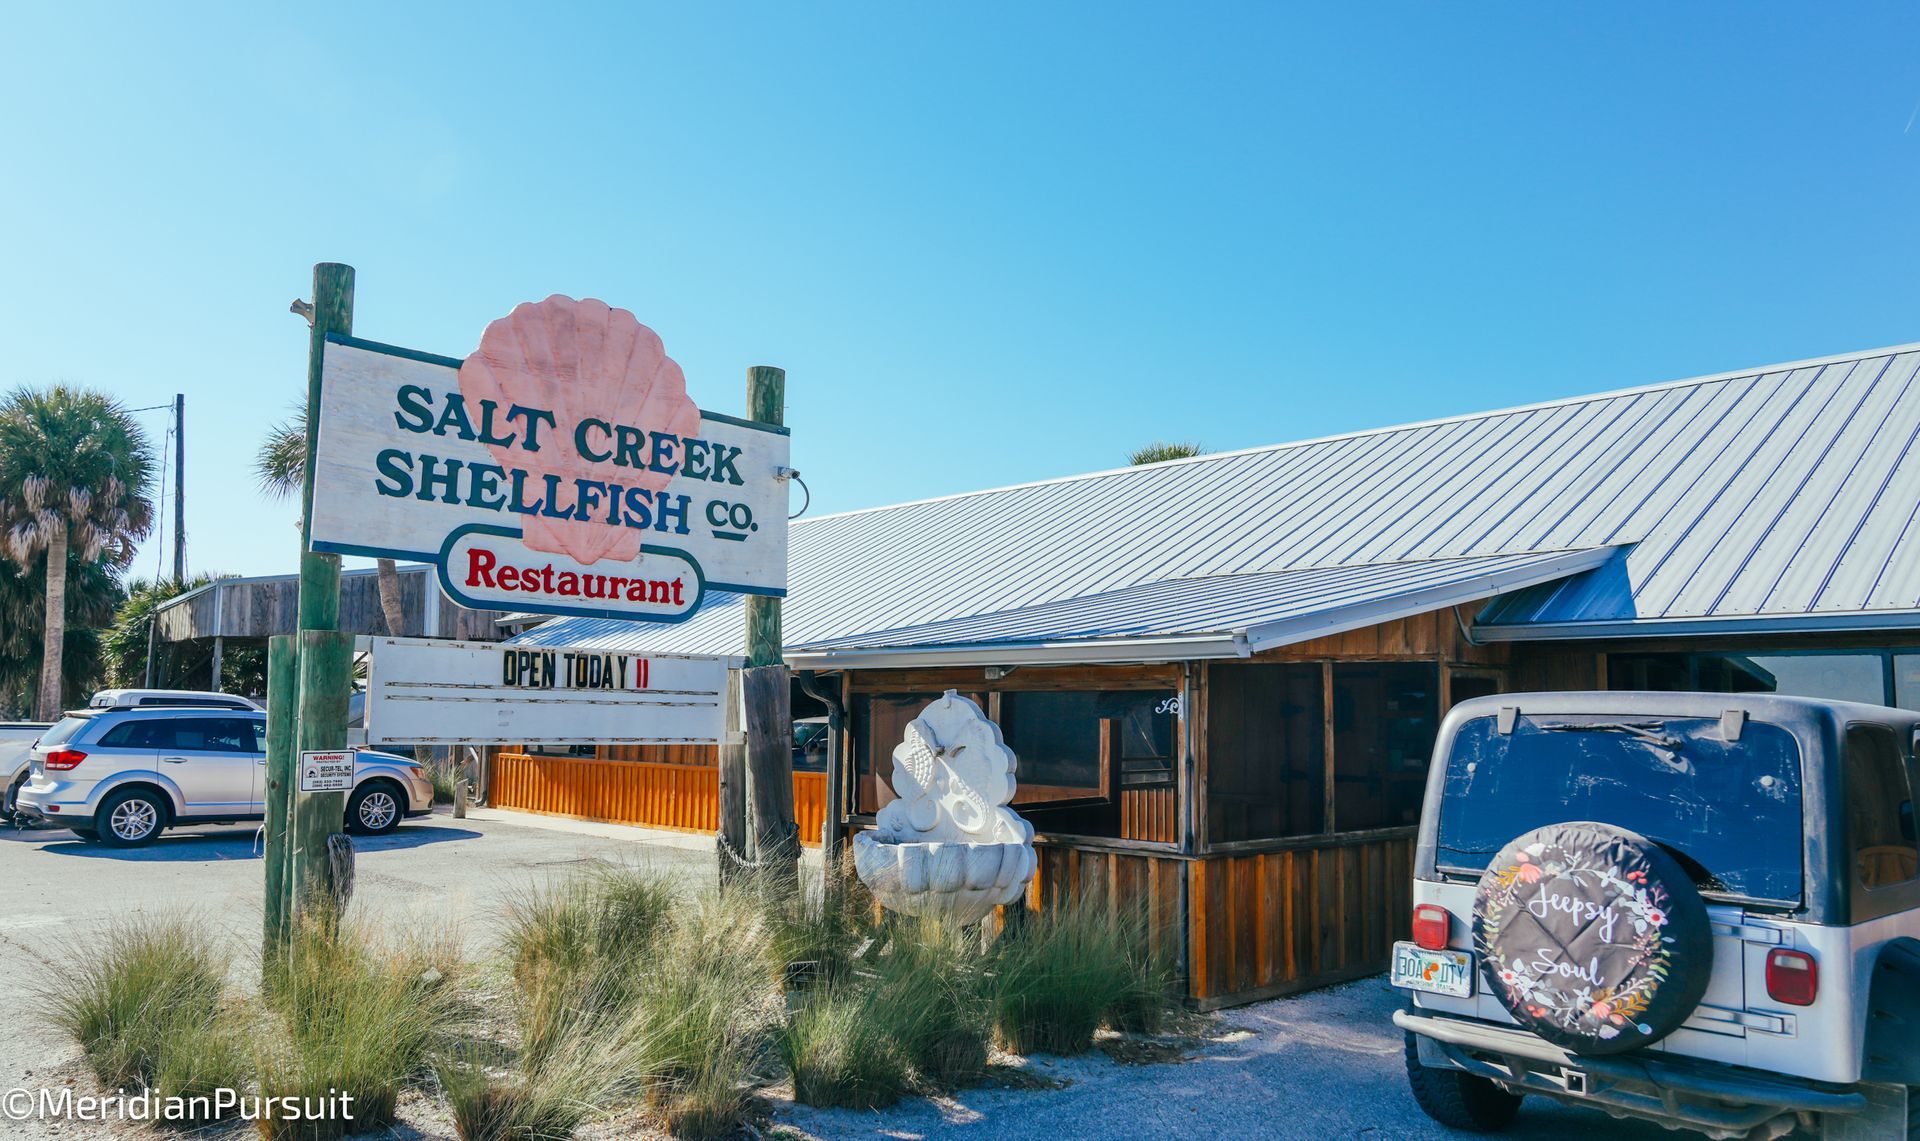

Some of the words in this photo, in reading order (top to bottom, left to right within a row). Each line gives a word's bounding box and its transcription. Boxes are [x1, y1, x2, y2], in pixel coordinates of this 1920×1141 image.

[394, 385, 556, 452] SALT
[574, 418, 744, 486] CREEK
[375, 448, 691, 534] SHELLFISH
[464, 548, 685, 606] Restaurant
[503, 650, 556, 688] OPEN
[564, 653, 628, 689] TODAY
[1528, 882, 1619, 943] Jeepsy
[1531, 948, 1604, 986] Soul
